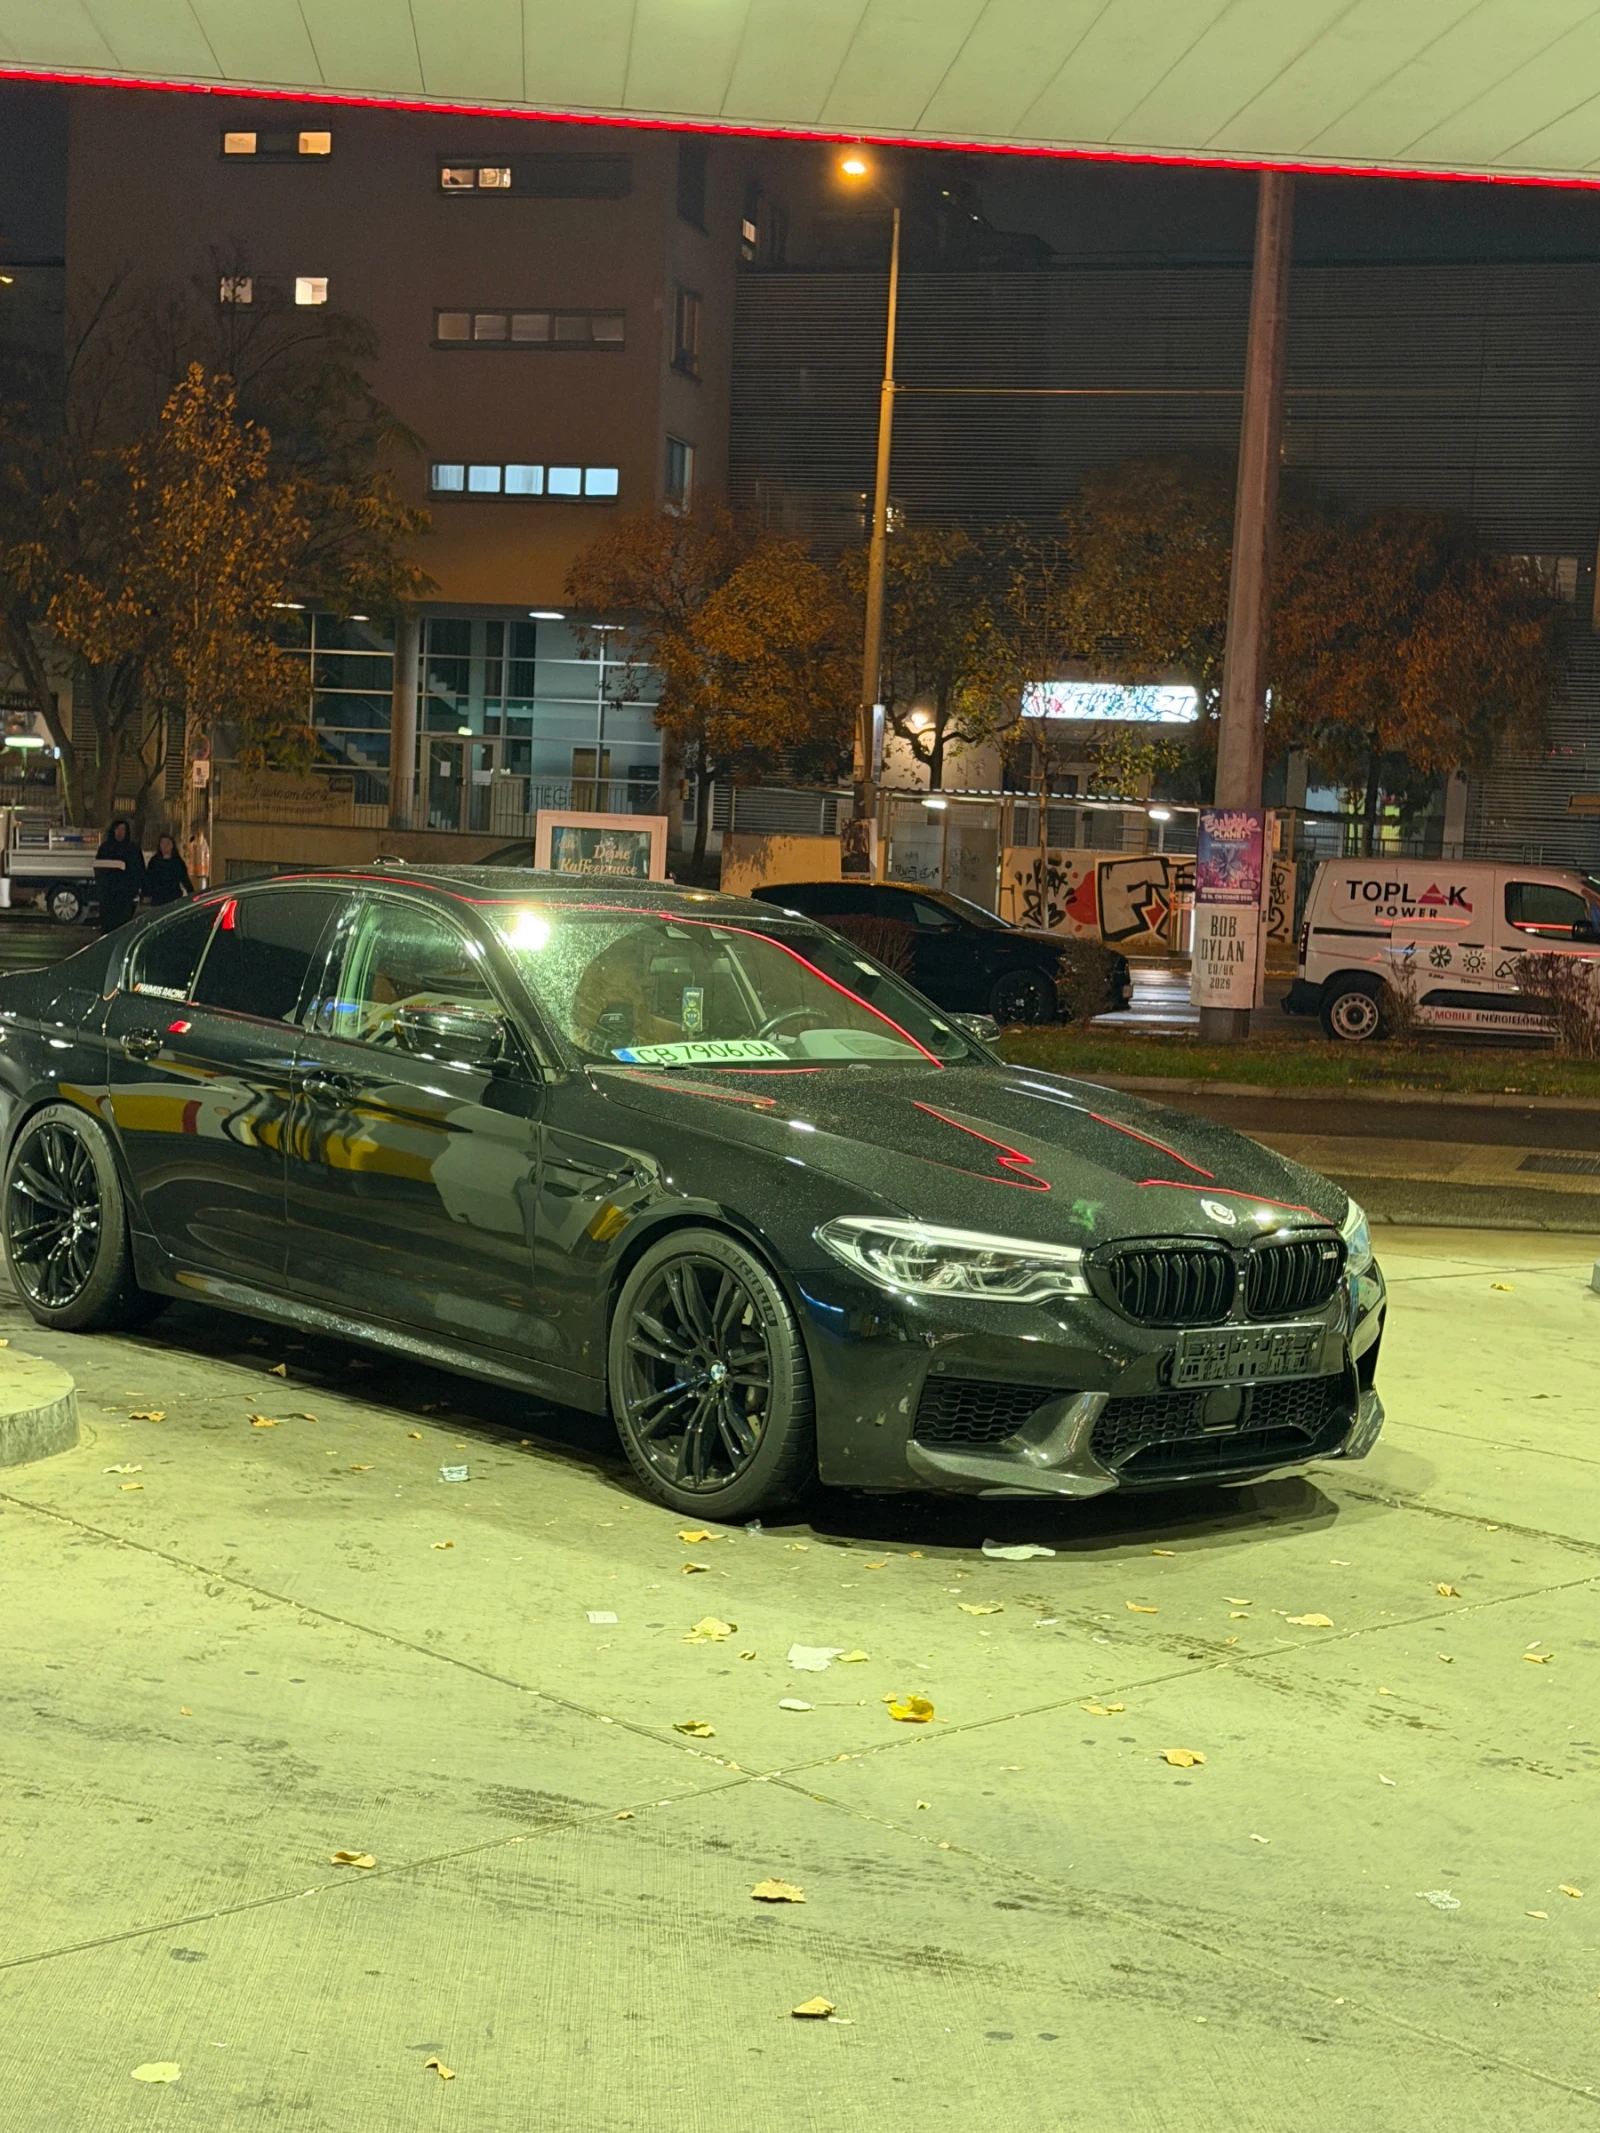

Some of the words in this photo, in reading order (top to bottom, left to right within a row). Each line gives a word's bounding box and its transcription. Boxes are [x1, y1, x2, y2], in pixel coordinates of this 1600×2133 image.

[1213, 830, 1246, 839] PLANET
[593, 844, 631, 861] Deine
[560, 857, 638, 876] Kaffeepause
[1375, 905, 1438, 918] POWER
[1211, 915, 1237, 937] BOB
[1201, 939, 1245, 962] DYLAN
[1208, 963, 1234, 976] EU/UK
[162, 987, 187, 1000] RACING
[1434, 1011, 1473, 1021] MOBILE
[724, 1247, 778, 1327] MICHELIN
